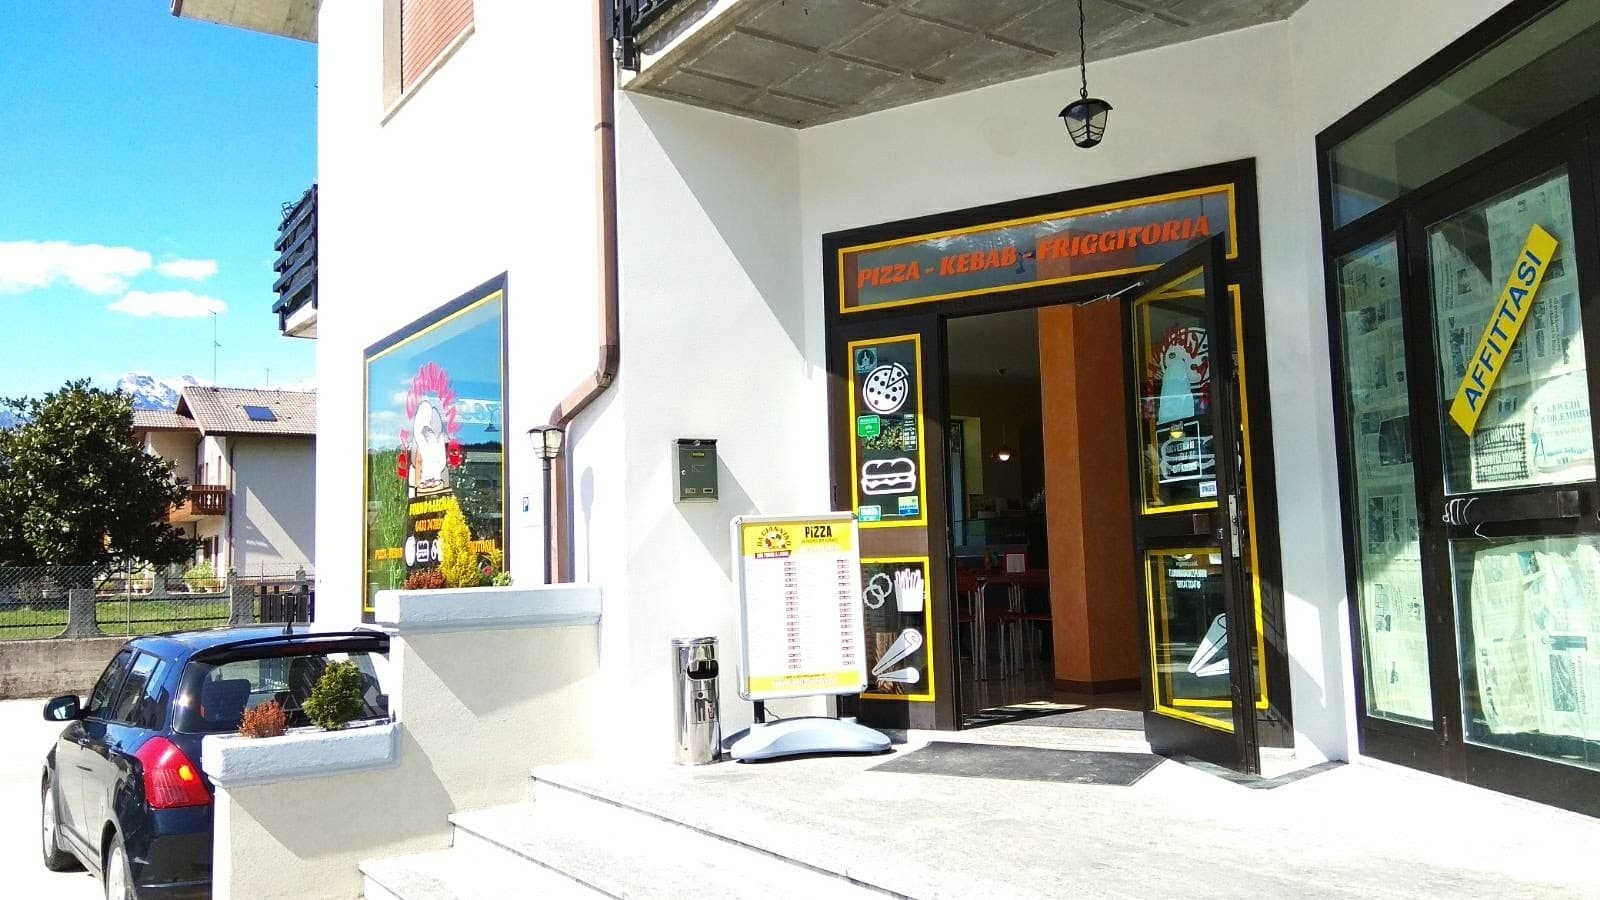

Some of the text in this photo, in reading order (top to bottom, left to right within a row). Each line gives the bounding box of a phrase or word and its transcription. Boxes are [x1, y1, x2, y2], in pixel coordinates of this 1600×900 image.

[857, 262, 920, 289] PIZZA
[940, 247, 1018, 277] KEBAB
[1036, 215, 1210, 261] FRIGGITORIA
[1464, 249, 1543, 413] AFFITTASI
